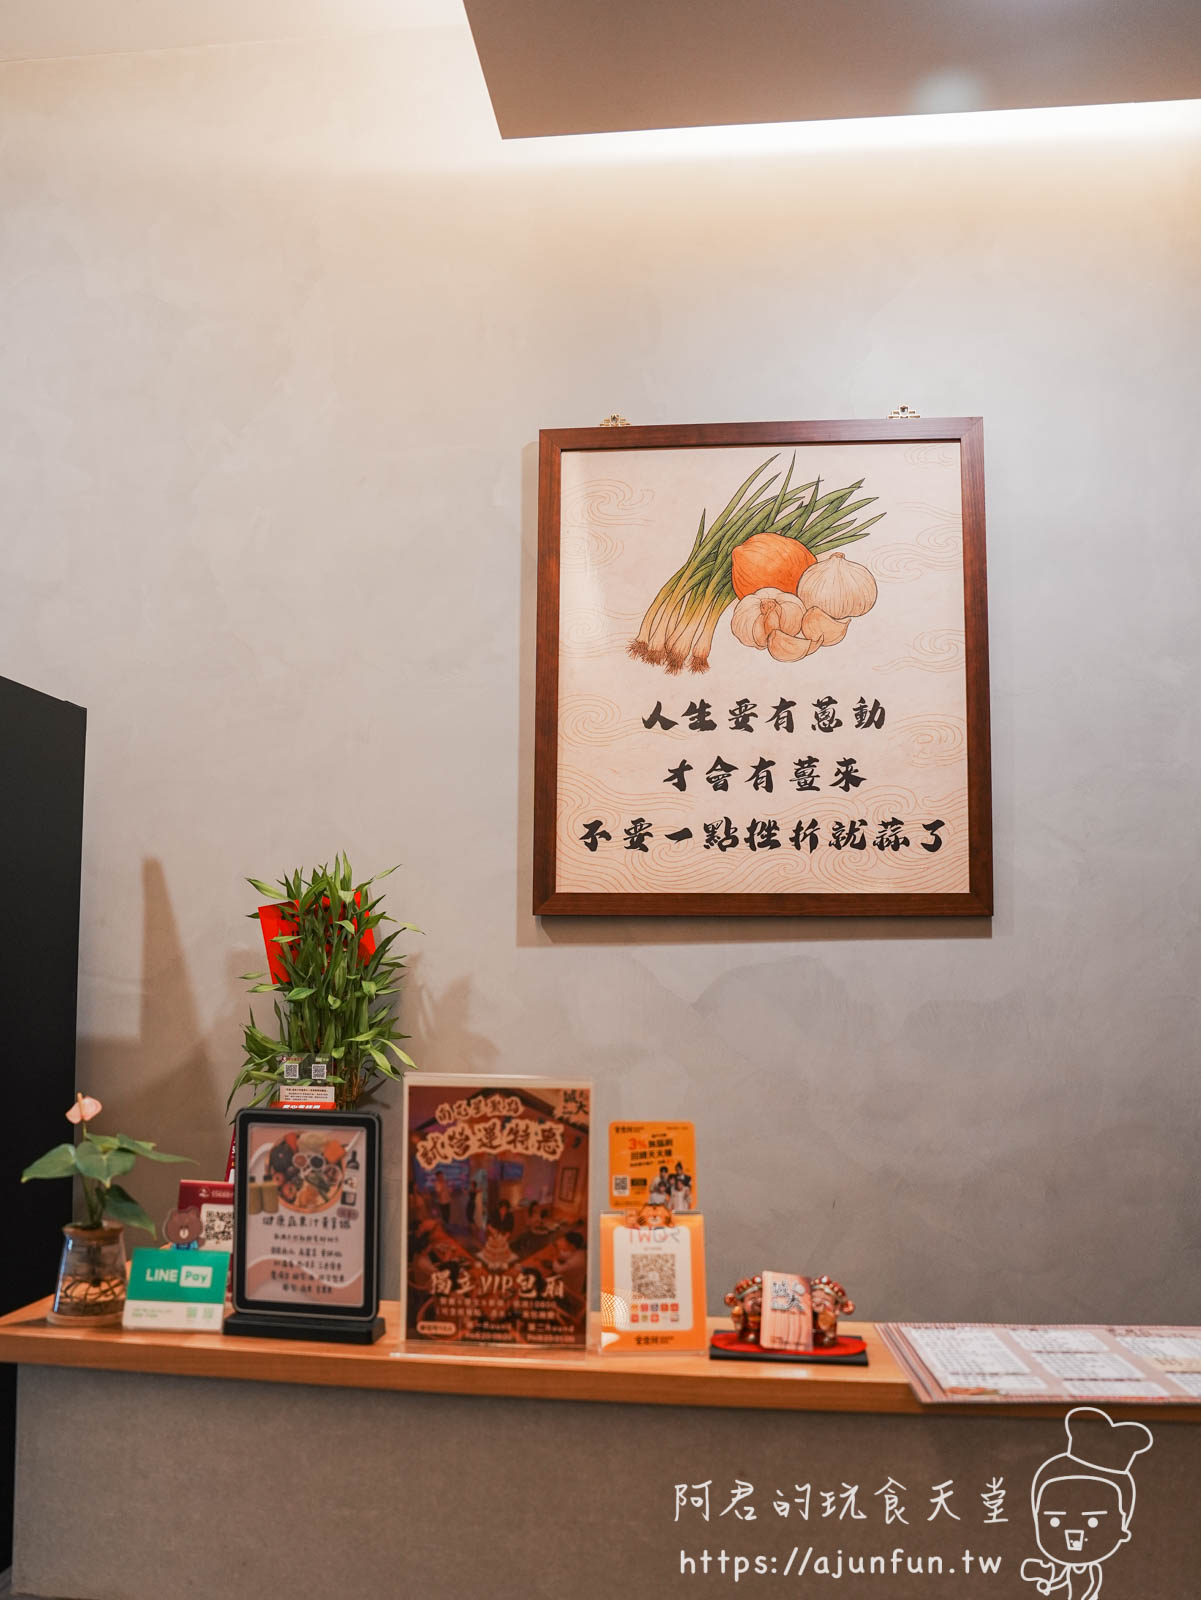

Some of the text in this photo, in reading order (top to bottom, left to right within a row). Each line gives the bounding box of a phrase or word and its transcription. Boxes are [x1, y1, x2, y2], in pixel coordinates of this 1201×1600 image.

[642, 696, 886, 733] 人生要有蔥動
[664, 756, 867, 793] 才會有薑來
[579, 817, 946, 853] 不要一點挫折就蒜了
[146, 1268, 208, 1284] LINE Pay
